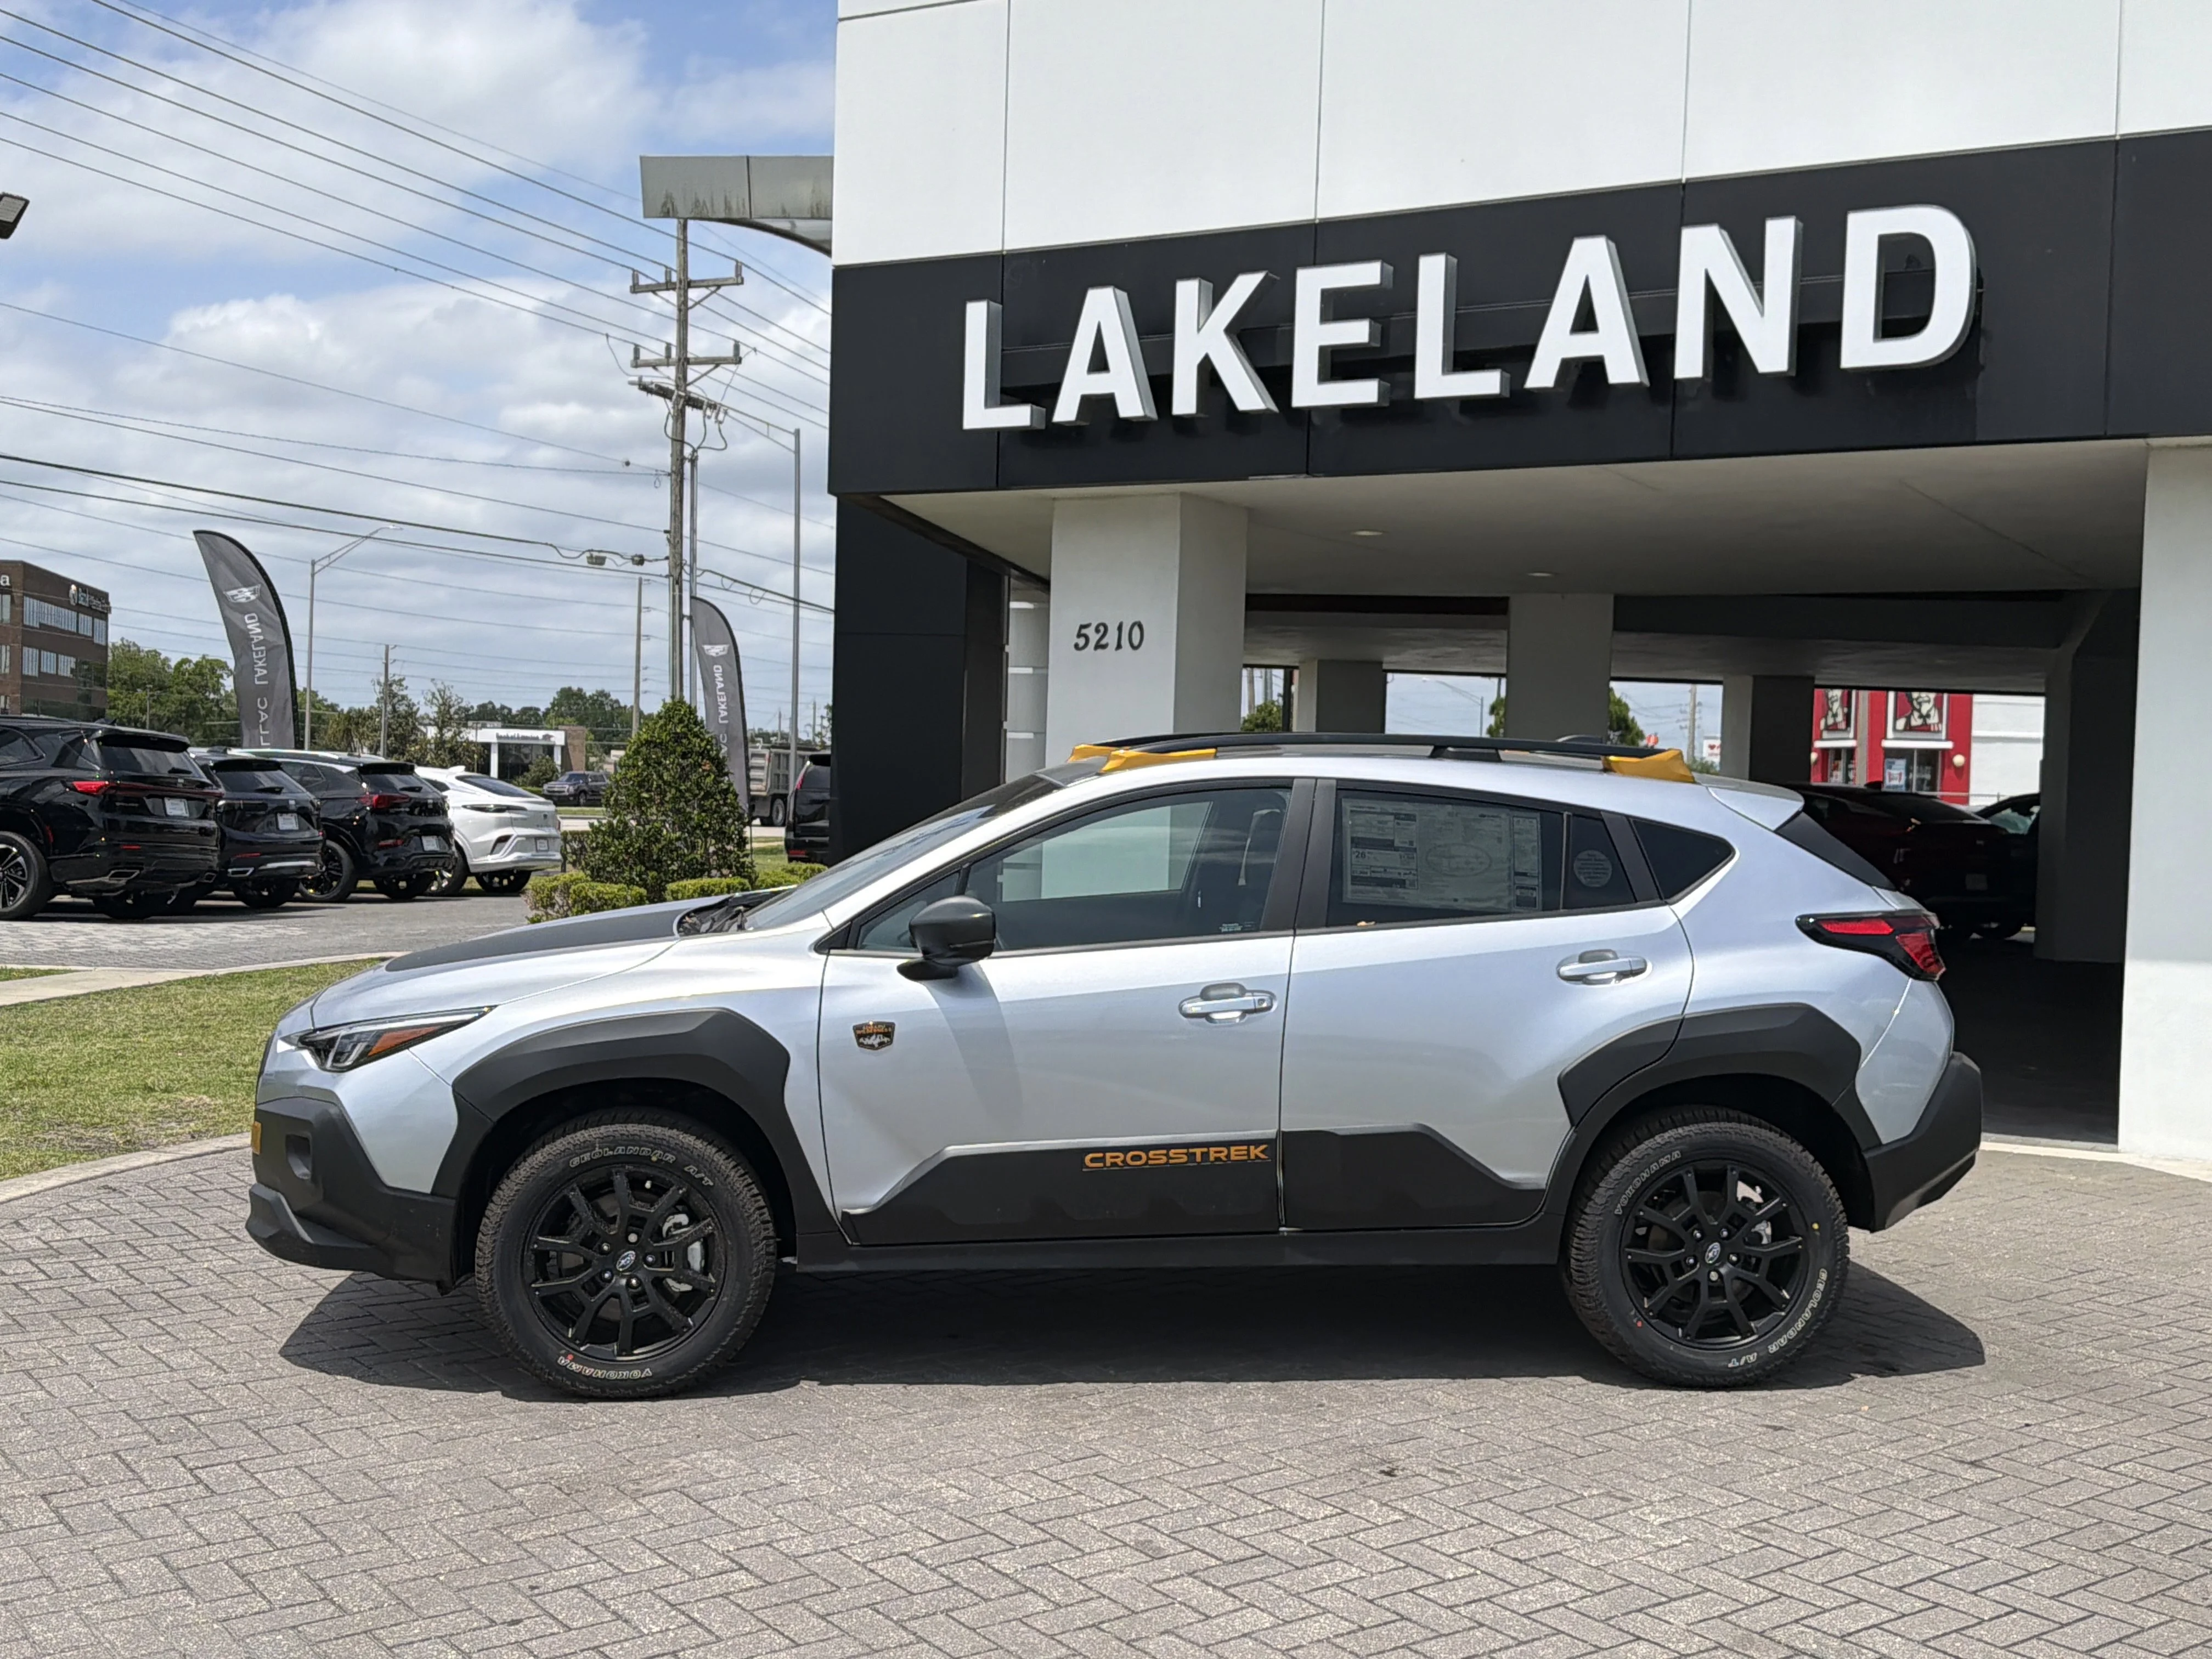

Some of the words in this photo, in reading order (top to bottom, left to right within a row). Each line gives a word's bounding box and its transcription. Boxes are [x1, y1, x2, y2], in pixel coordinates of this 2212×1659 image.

[963, 204, 1976, 430] LAKELAND
[1073, 620, 1145, 652] 5210
[569, 1146, 676, 1167] GEOLANDAR
[684, 1165, 714, 1186] A/T
[1084, 1144, 1269, 1168] CROSSTREK
[1614, 1150, 1681, 1215] YOKOHAMA
[1767, 1268, 1827, 1354] GEOLANDAR
[557, 1356, 653, 1380] YOKOHAMA
[1728, 1352, 1758, 1368] A/T
